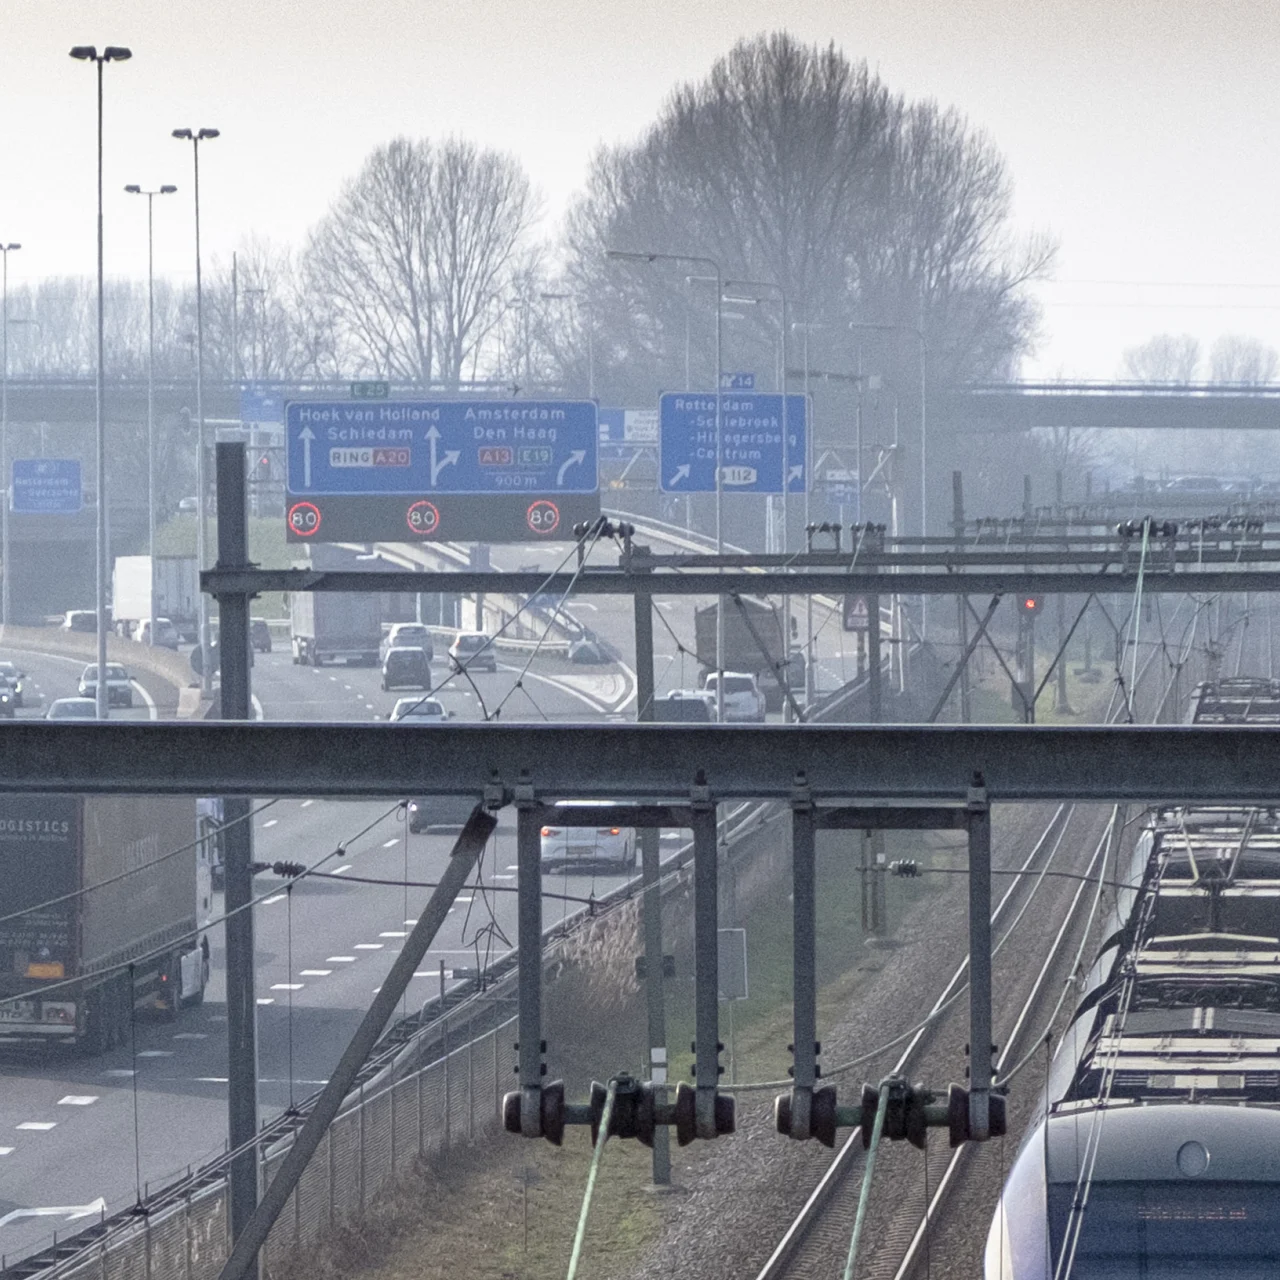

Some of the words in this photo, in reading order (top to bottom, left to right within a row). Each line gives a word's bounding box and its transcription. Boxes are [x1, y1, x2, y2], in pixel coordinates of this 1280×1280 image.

[675, 399, 754, 411] Rottedam
[299, 408, 340, 422] Hoek
[345, 410, 374, 422] van
[380, 407, 440, 422] Holland
[464, 407, 566, 421] Amsterdam
[327, 426, 414, 440] Schiedam
[474, 426, 508, 440] Den
[513, 426, 557, 442] Haag
[331, 451, 370, 463] RING
[375, 451, 408, 463] A20
[482, 449, 510, 462] A13
[495, 475, 522, 486] 900
[524, 476, 538, 486] m
[291, 511, 317, 526] 80
[410, 510, 435, 526] 80
[529, 510, 556, 525] 80
